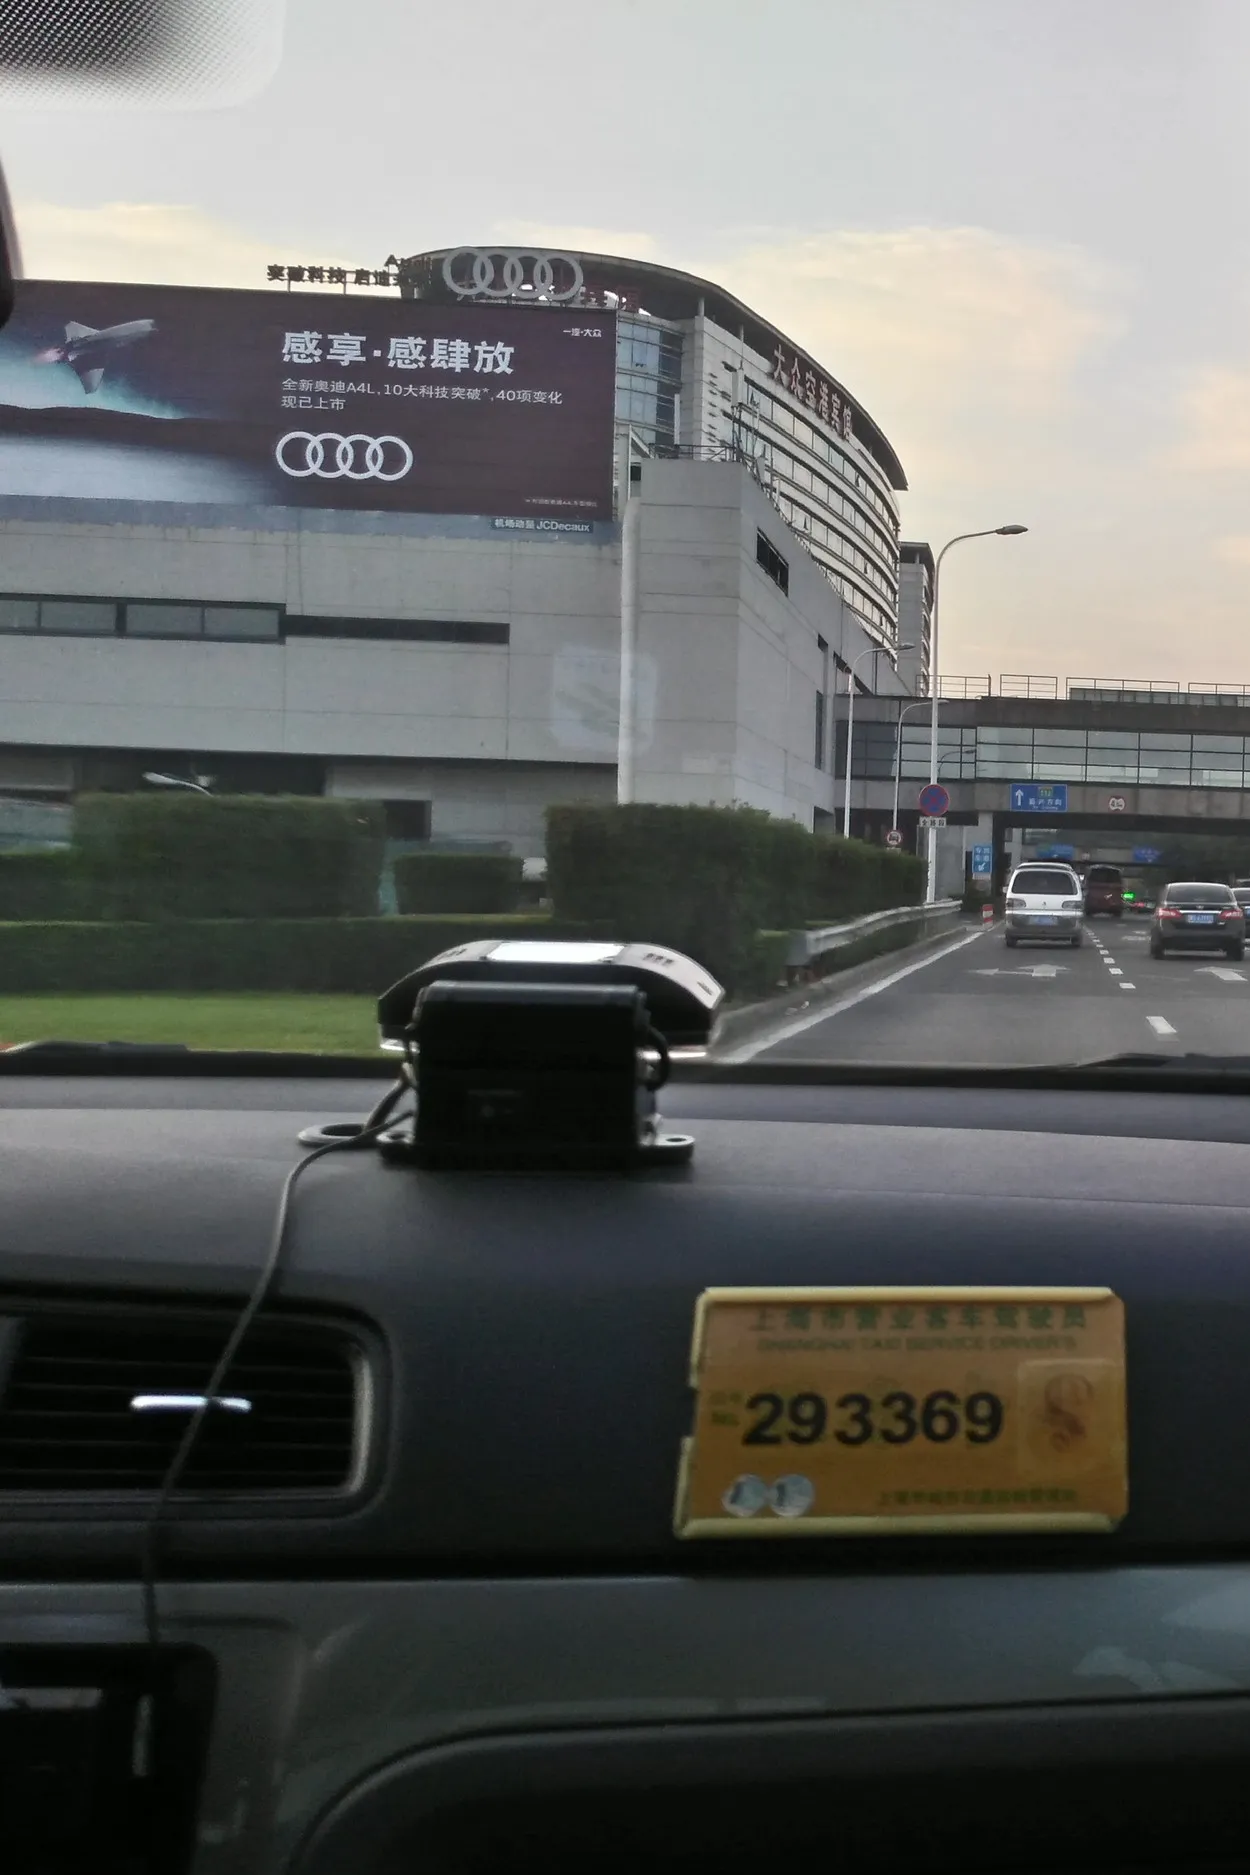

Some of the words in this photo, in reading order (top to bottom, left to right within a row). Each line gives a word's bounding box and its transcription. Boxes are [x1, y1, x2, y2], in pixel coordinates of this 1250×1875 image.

[281, 330, 515, 375] 感享·感肆放
[281, 395, 346, 411] 现已上市
[537, 520, 590, 532] JCDecaux
[741, 1390, 1005, 1446] 293369
